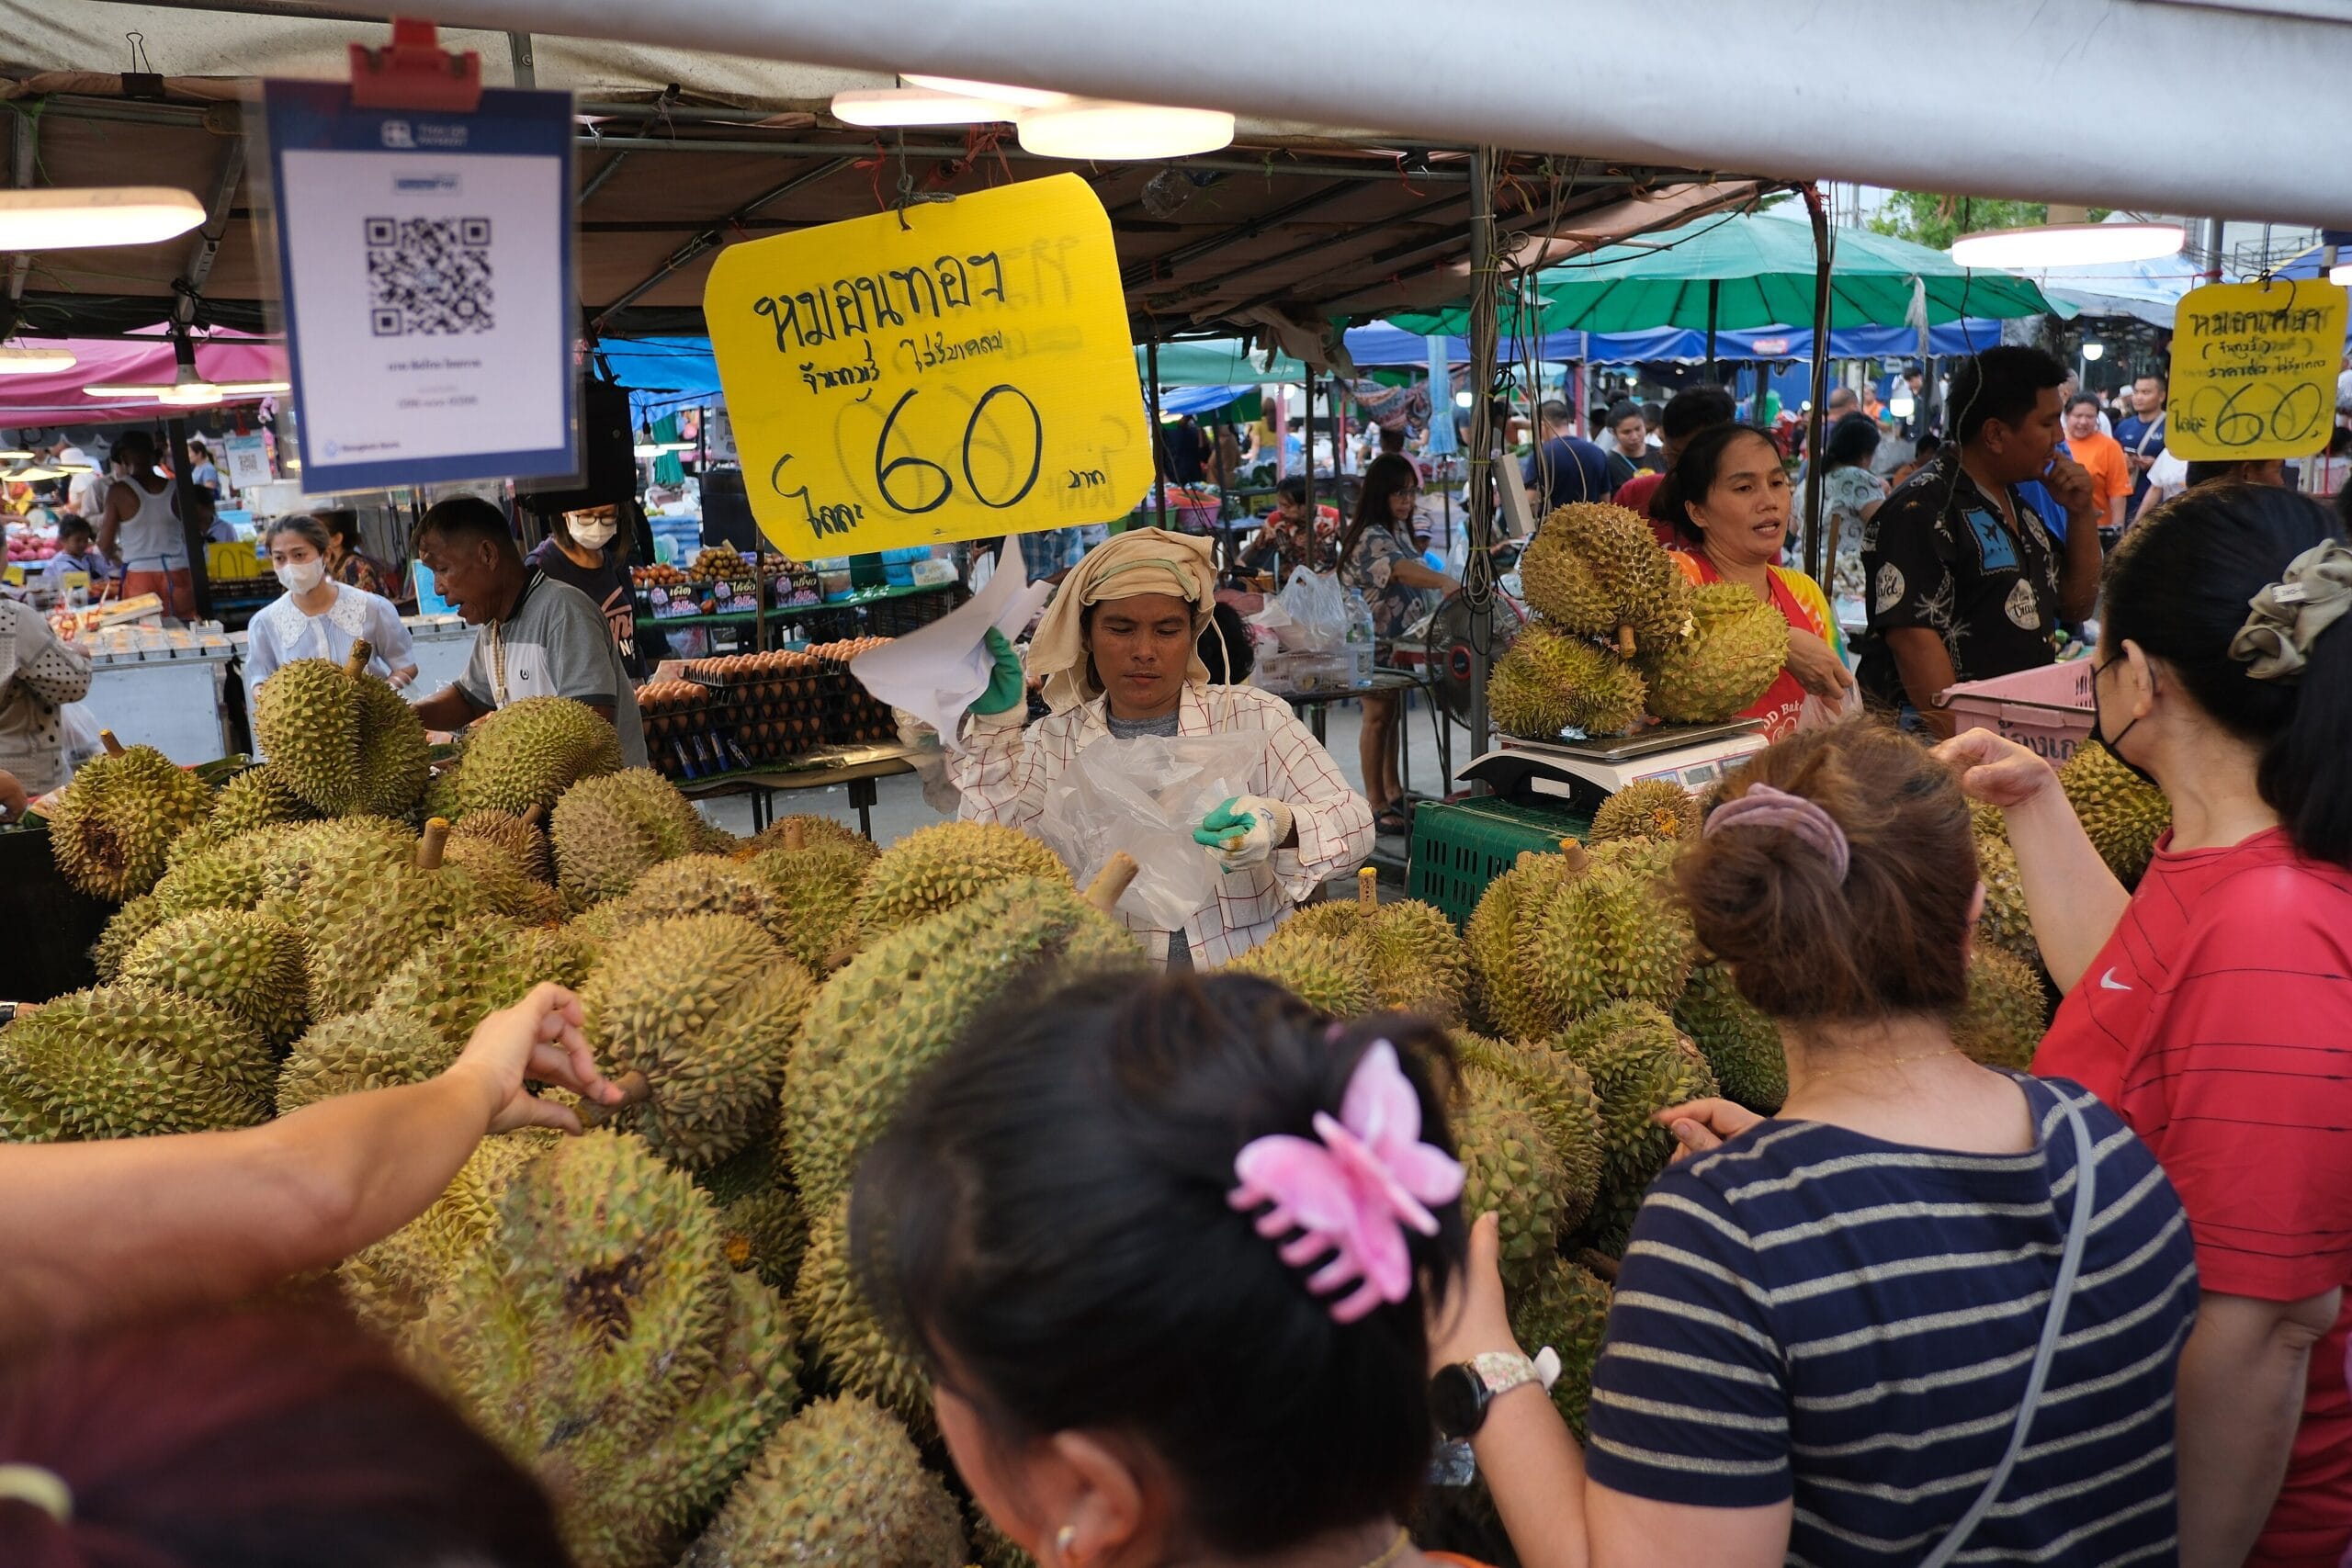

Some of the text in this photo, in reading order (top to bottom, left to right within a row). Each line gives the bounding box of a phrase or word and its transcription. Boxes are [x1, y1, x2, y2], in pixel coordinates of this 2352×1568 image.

[753, 251, 1005, 353] หมอนทอง
[876, 386, 1042, 513] 60
